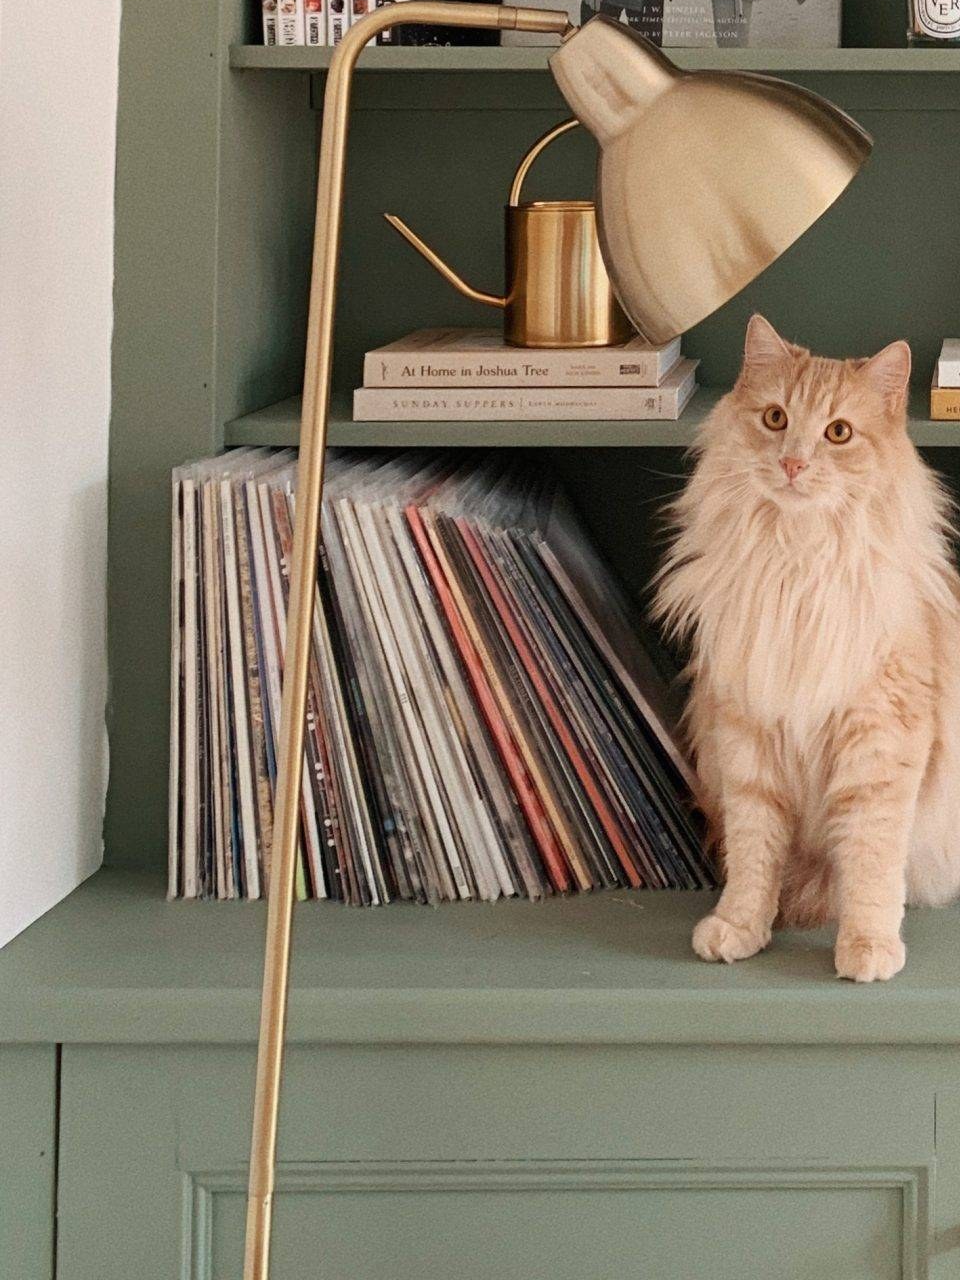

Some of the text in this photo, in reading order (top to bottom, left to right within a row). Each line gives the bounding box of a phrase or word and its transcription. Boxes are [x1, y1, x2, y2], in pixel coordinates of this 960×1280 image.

[401, 364, 549, 377] At Home in Joshua Tree
[392, 400, 448, 408] SUNDAY
[456, 400, 514, 408] SUPPERS
